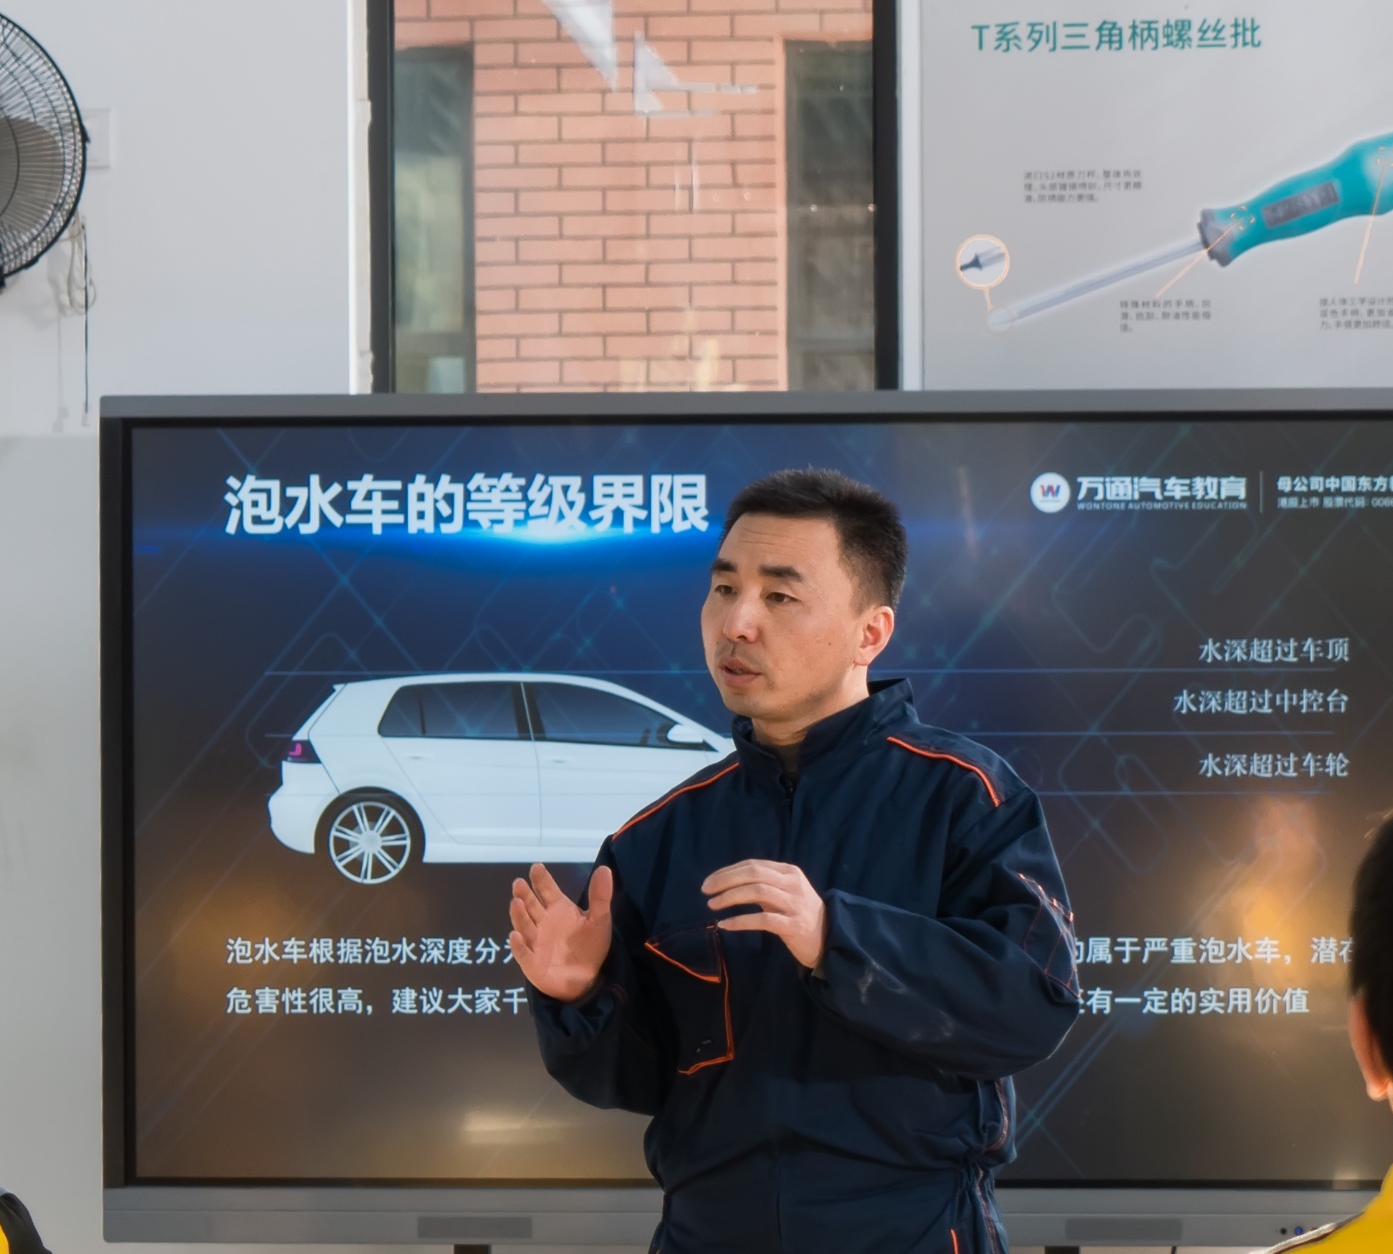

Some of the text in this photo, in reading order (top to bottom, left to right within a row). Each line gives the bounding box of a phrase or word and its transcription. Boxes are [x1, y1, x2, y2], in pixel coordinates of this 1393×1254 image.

[970, 17, 1262, 52] T系列三角柄螺丝批
[1077, 476, 1247, 500] 万通汽车教育
[224, 473, 709, 535] 泡水车的等级界限
[1077, 501, 1247, 511] WONTONE AUTOMOTIVE EDUCATION
[1198, 637, 1350, 663] 水深超过车顶
[1173, 689, 1349, 715] 水深超过中控台
[1198, 752, 1350, 778] 水深超过车轮
[226, 987, 1310, 1015] 危害性很高，建议大家千 有一定的实用价值
